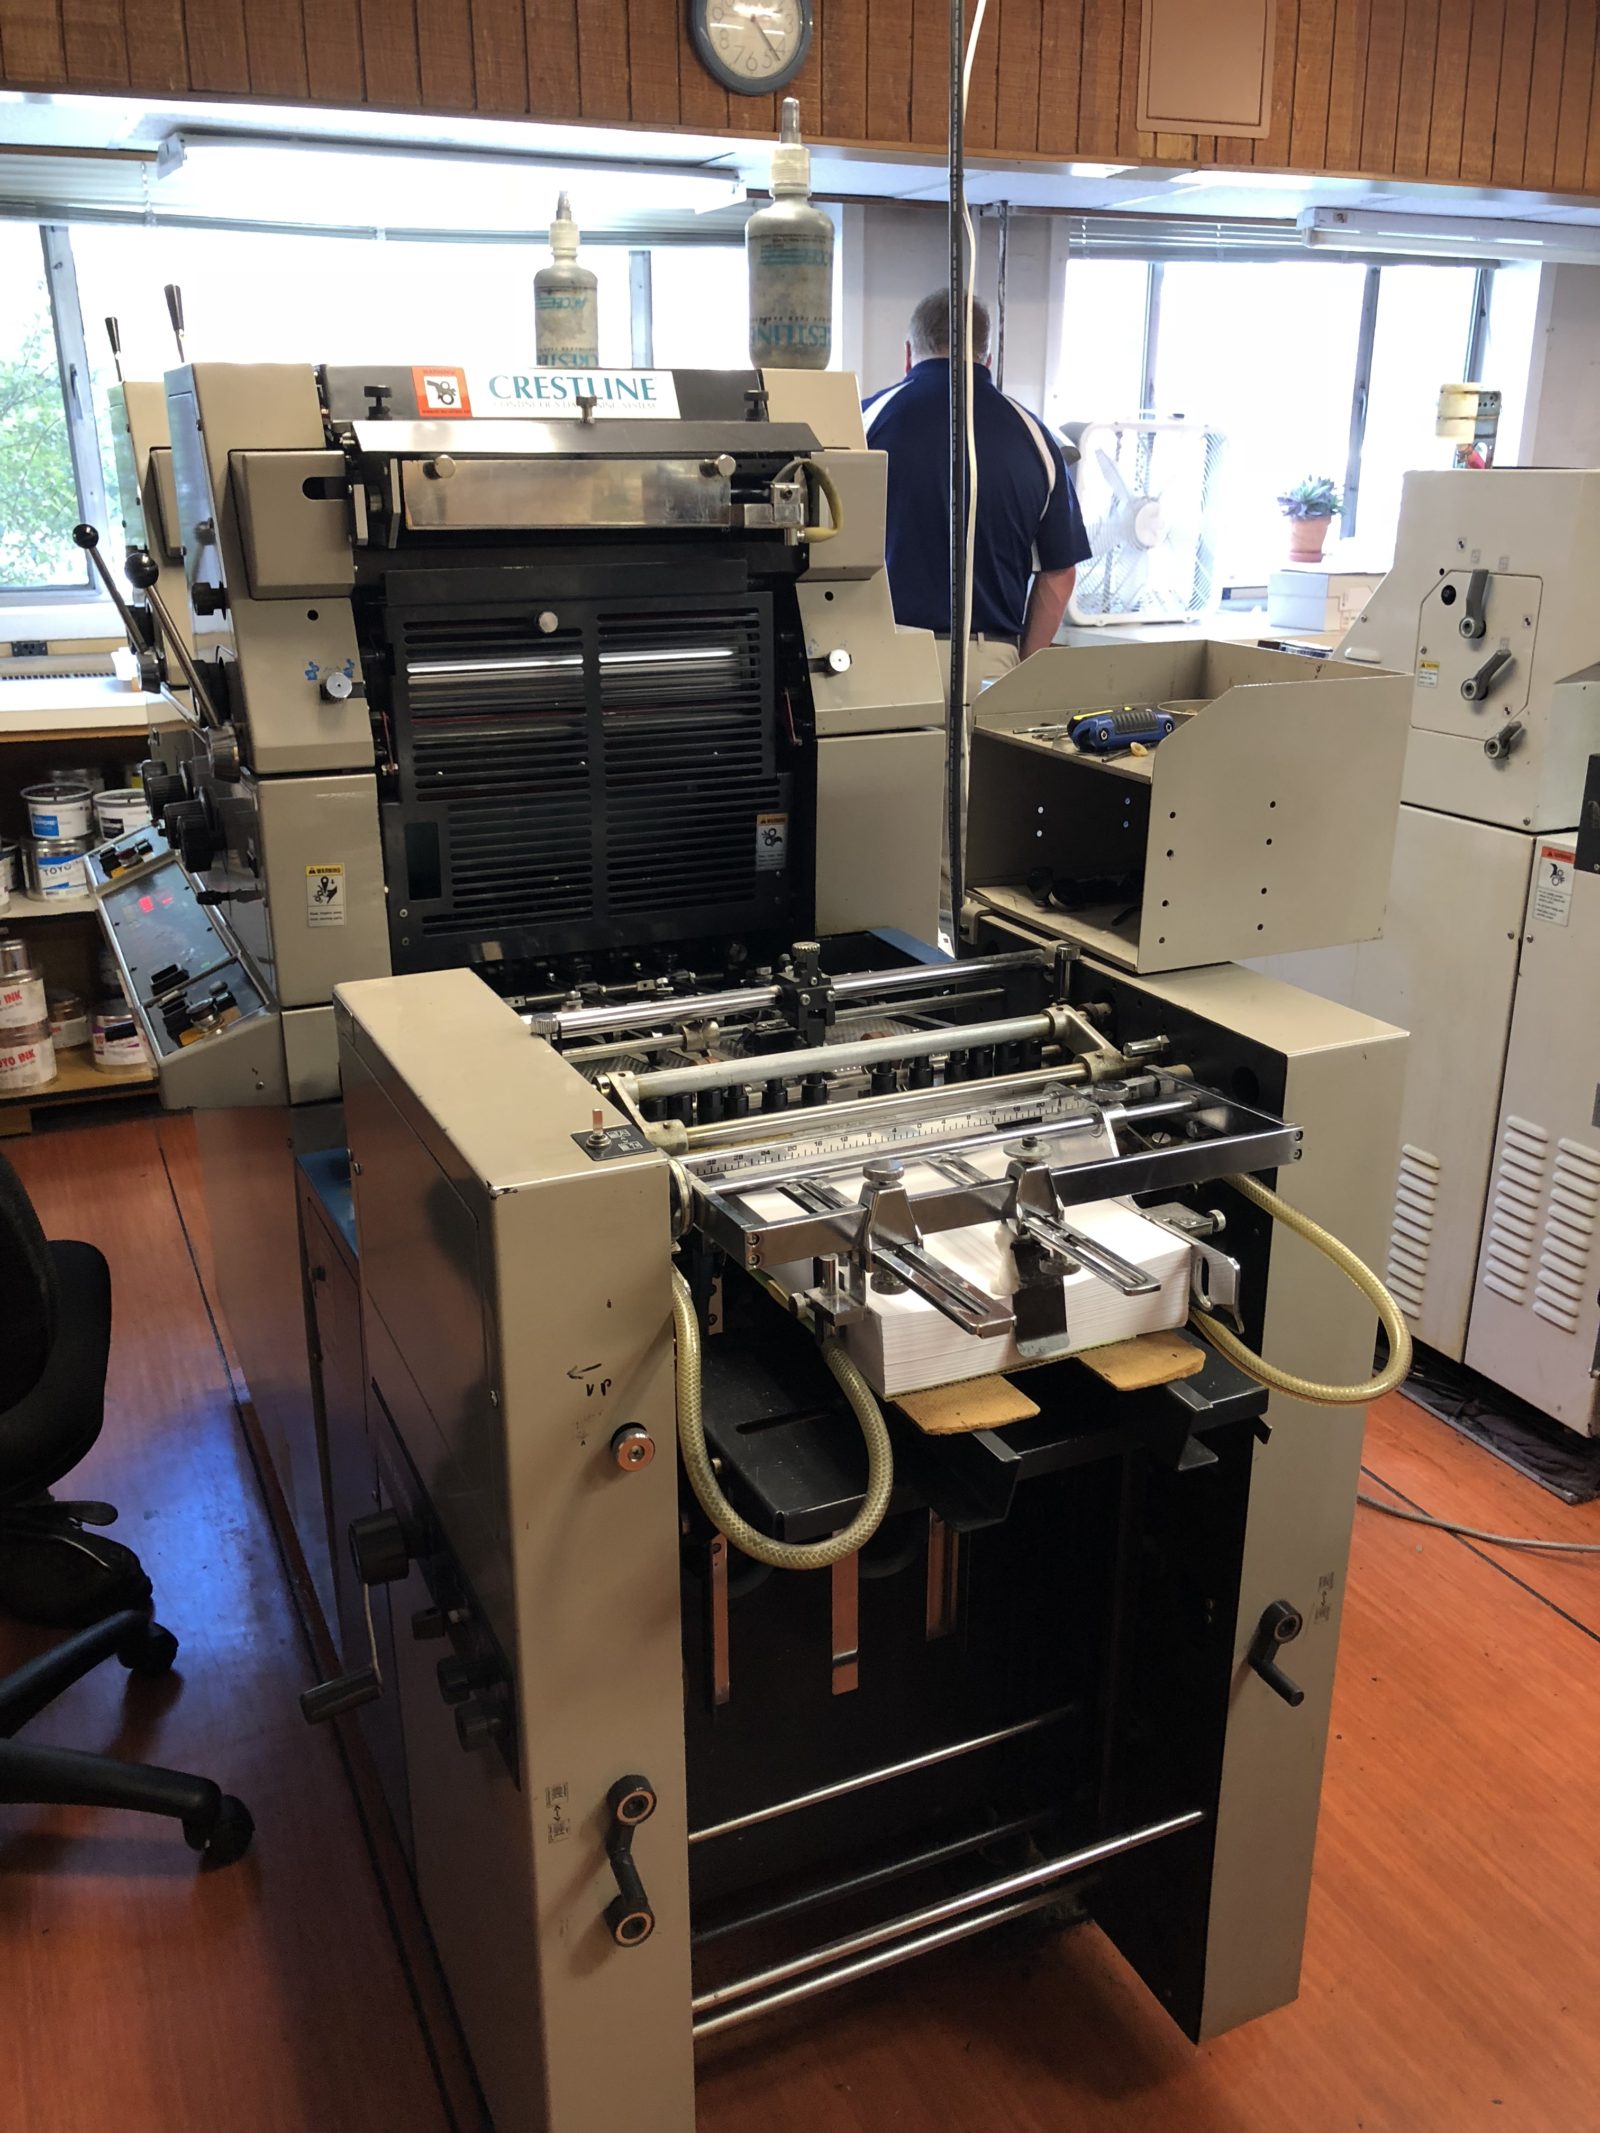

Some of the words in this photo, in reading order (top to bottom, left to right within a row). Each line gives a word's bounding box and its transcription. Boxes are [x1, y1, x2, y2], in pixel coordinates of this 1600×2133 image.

[719, 28, 730, 50] 8
[733, 44, 746, 64] 7
[745, 51, 759, 72] 6
[488, 374, 658, 401] CRESTLINE
[43, 863, 72, 876] TOYO
